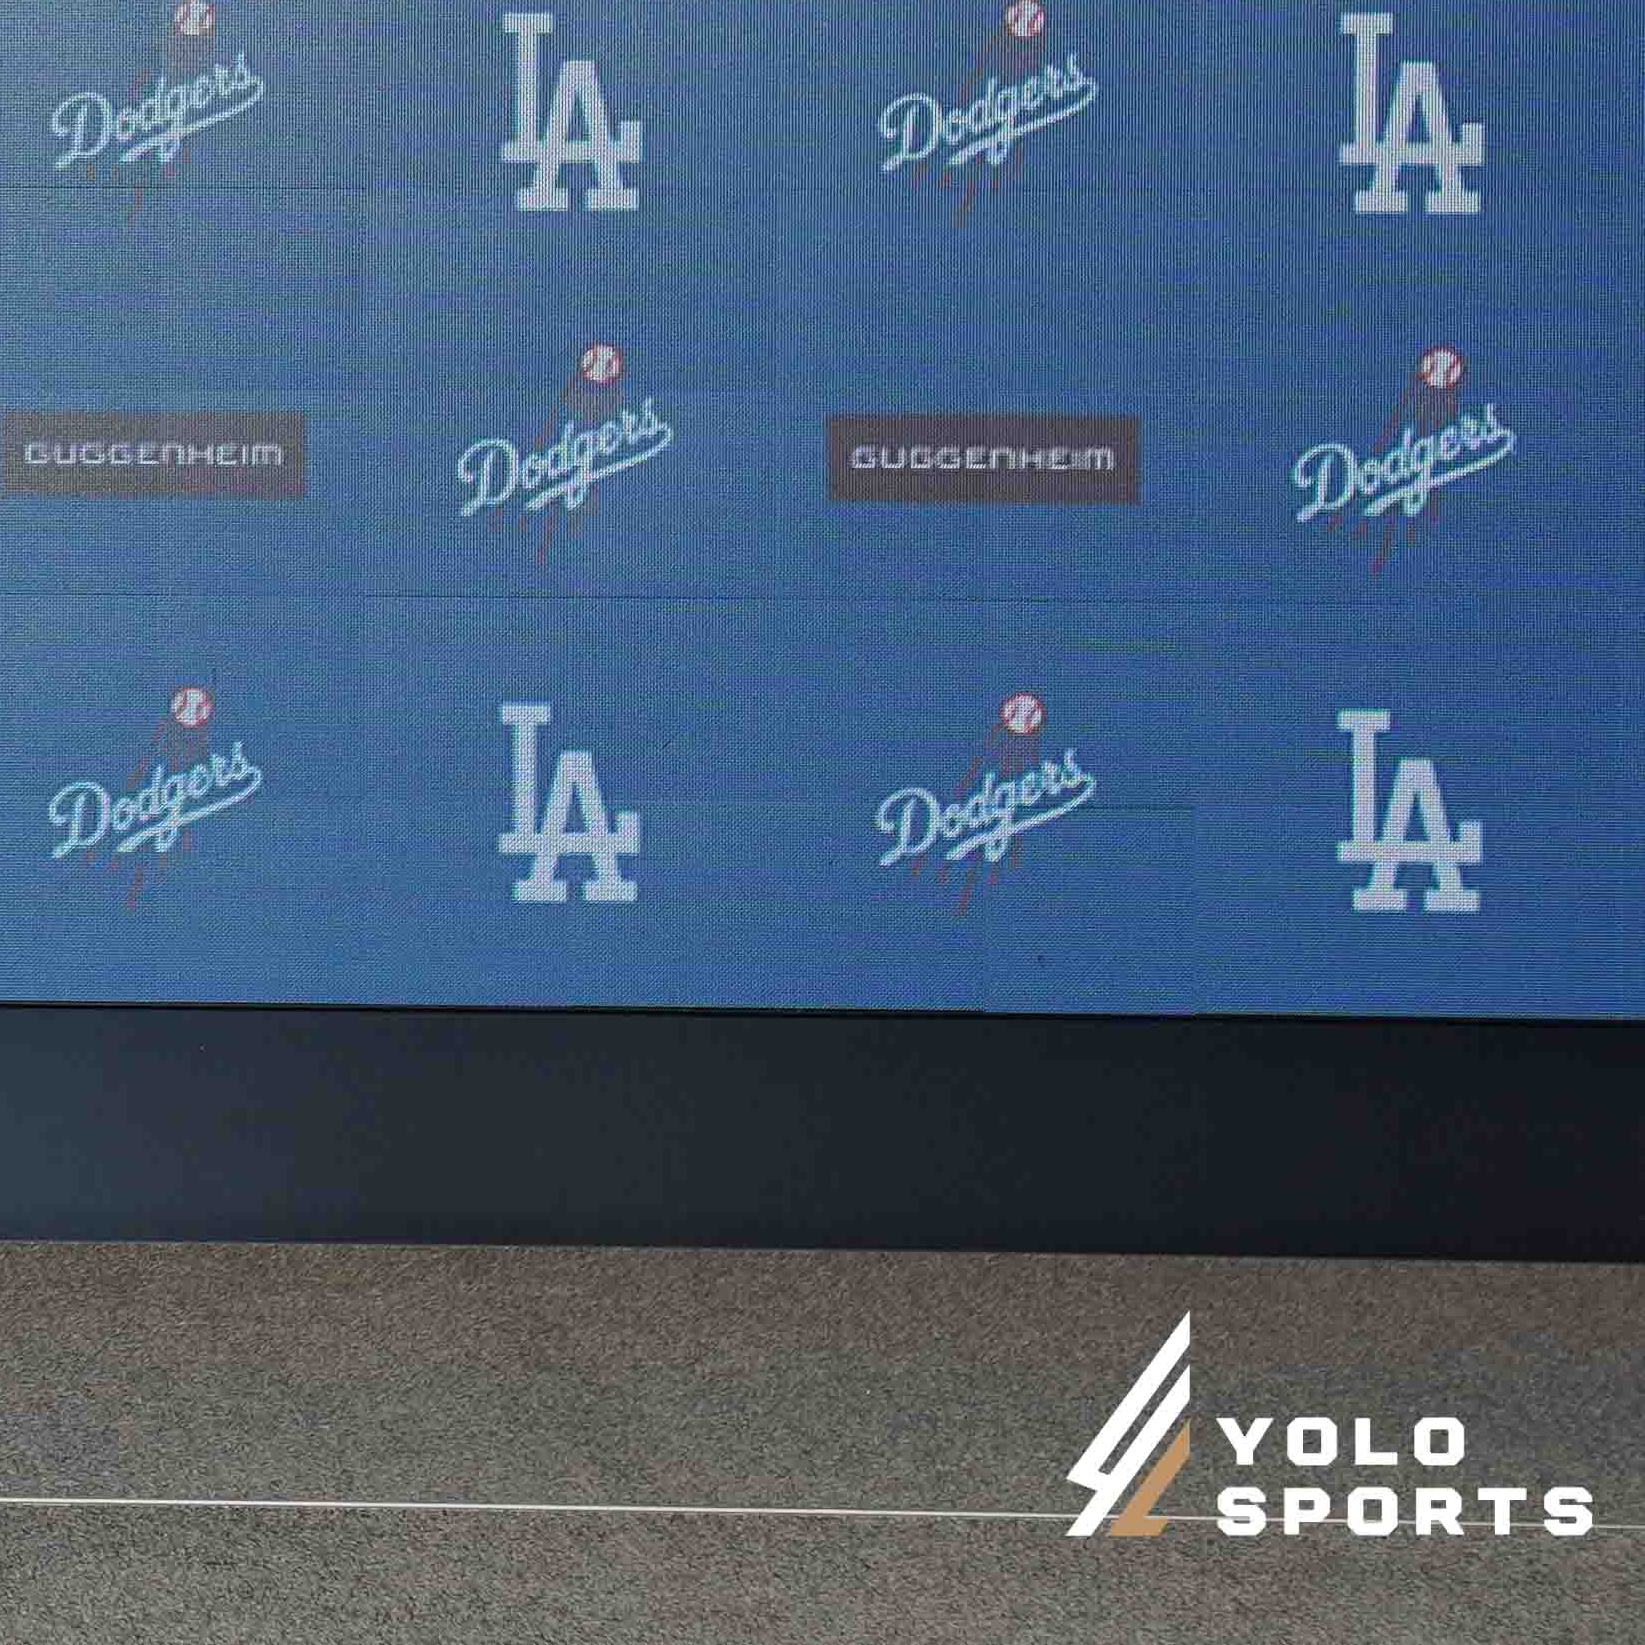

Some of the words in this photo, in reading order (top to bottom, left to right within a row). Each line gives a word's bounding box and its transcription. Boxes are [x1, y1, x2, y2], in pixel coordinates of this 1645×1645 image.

[51, 54, 265, 169] Dodgers
[500, 11, 643, 212] LA
[878, 53, 1099, 172] Dodgers
[1338, 11, 1486, 216] LA
[22, 440, 285, 469] GUGGENHEIM
[456, 396, 674, 517] Dodgers
[849, 444, 1117, 473] GUGGENHEIM
[1292, 401, 1516, 523] Dodgers
[48, 740, 262, 860] Dodgers
[497, 702, 642, 904] LA
[875, 747, 1097, 867] Dodgers
[1335, 708, 1485, 914] LA
